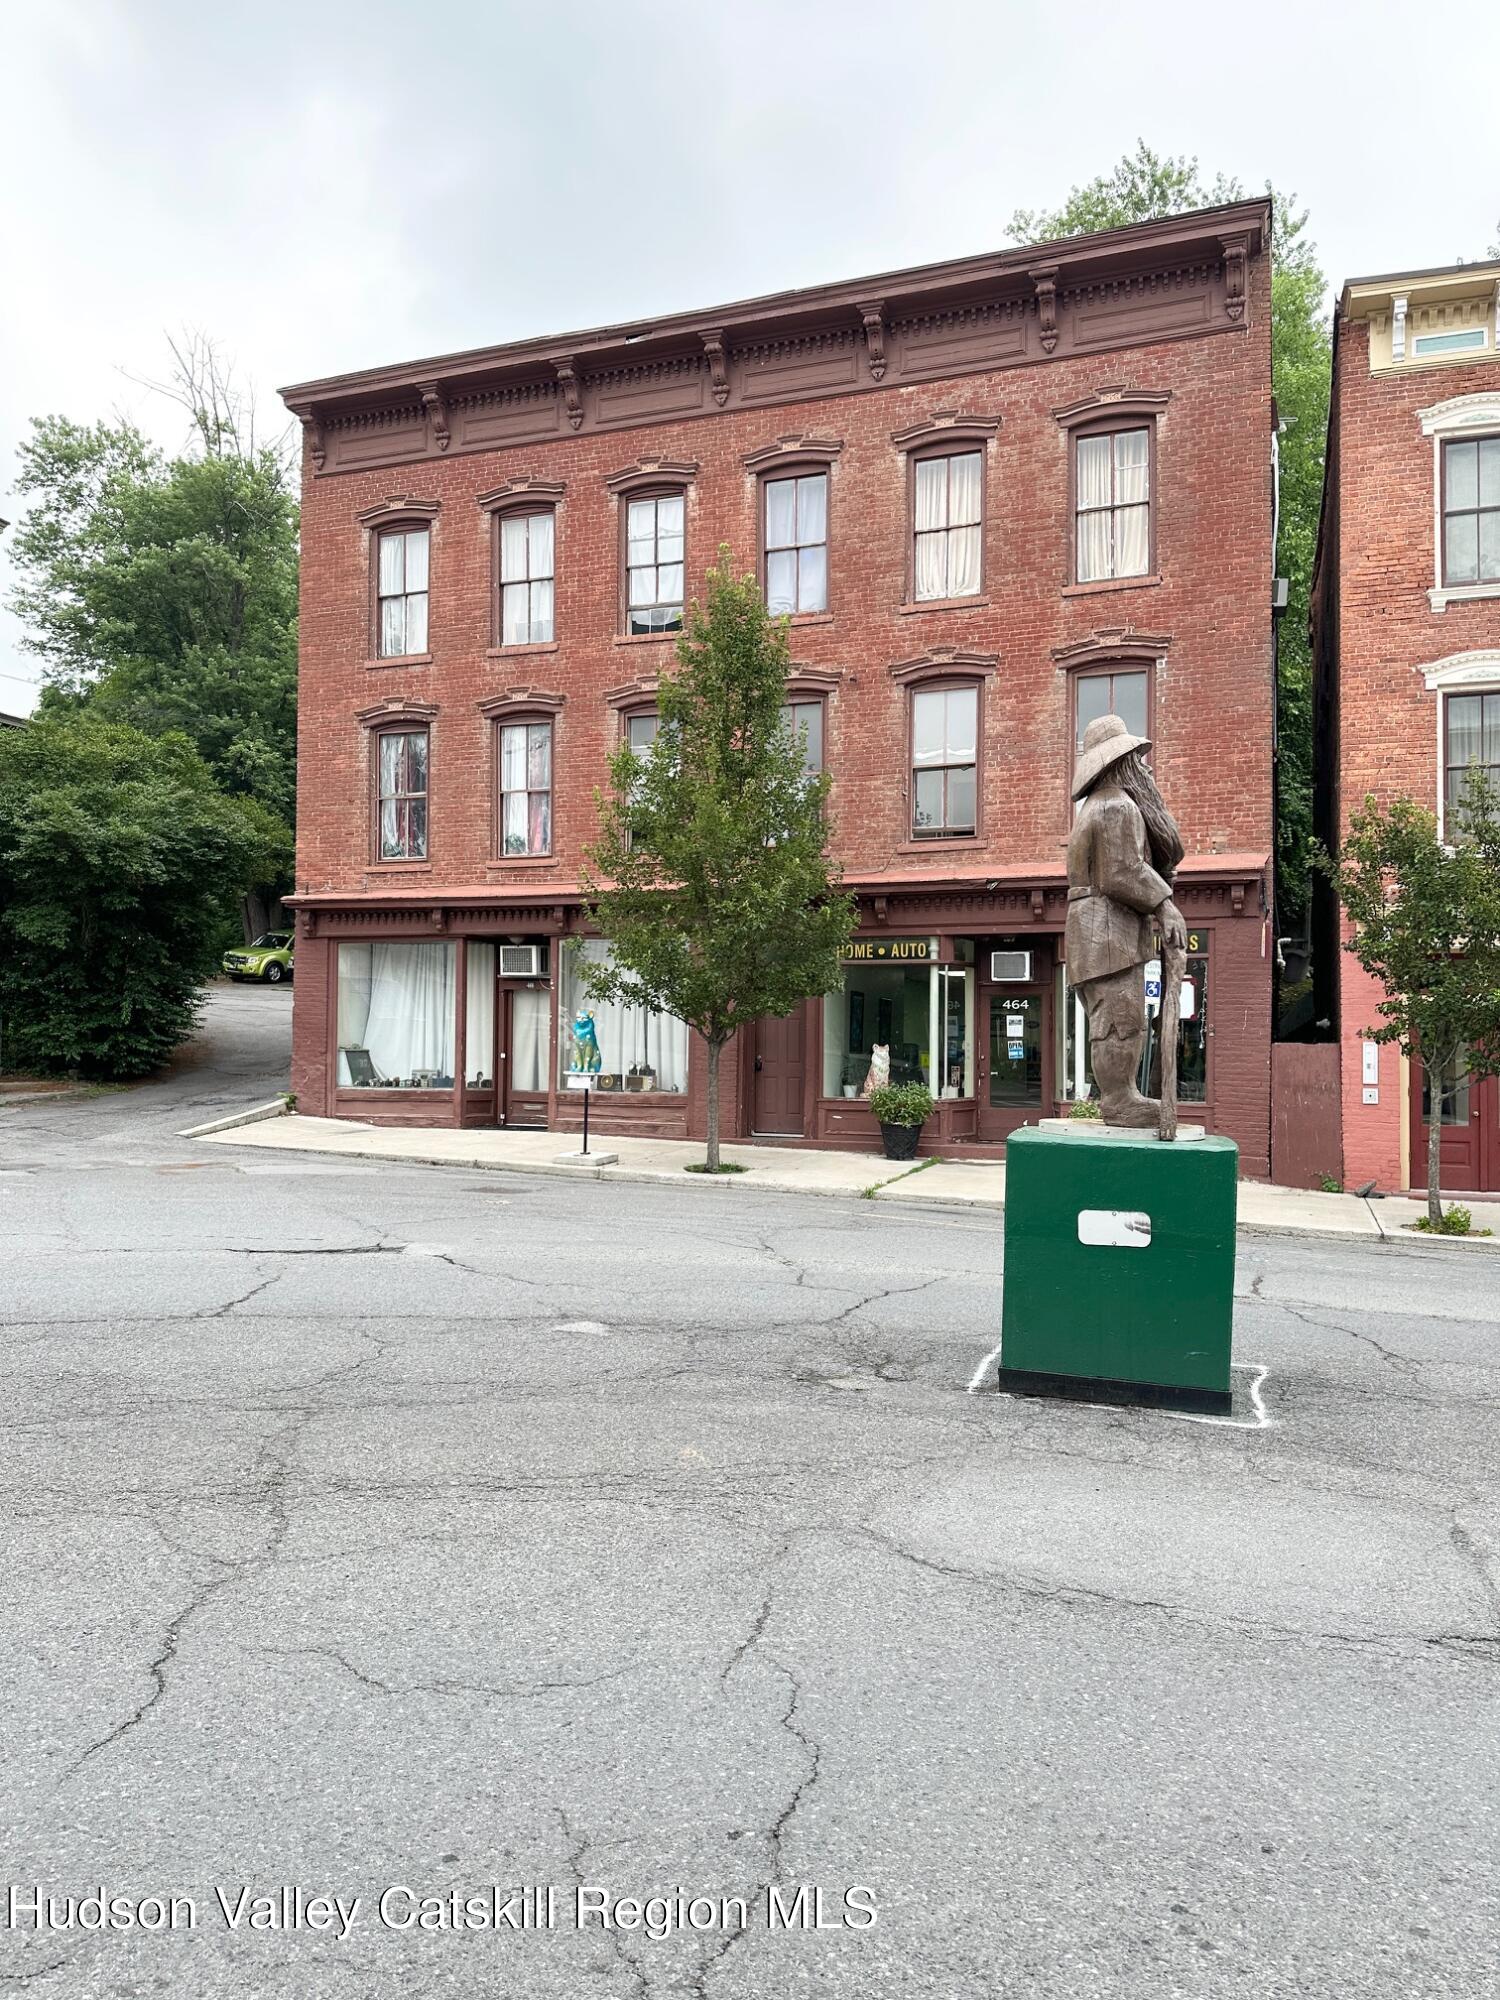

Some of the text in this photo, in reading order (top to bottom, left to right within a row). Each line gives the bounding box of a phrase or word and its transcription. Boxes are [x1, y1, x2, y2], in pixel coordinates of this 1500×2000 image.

[836, 943, 927, 958] HOME AUTO
[1002, 999, 1030, 1010] 464
